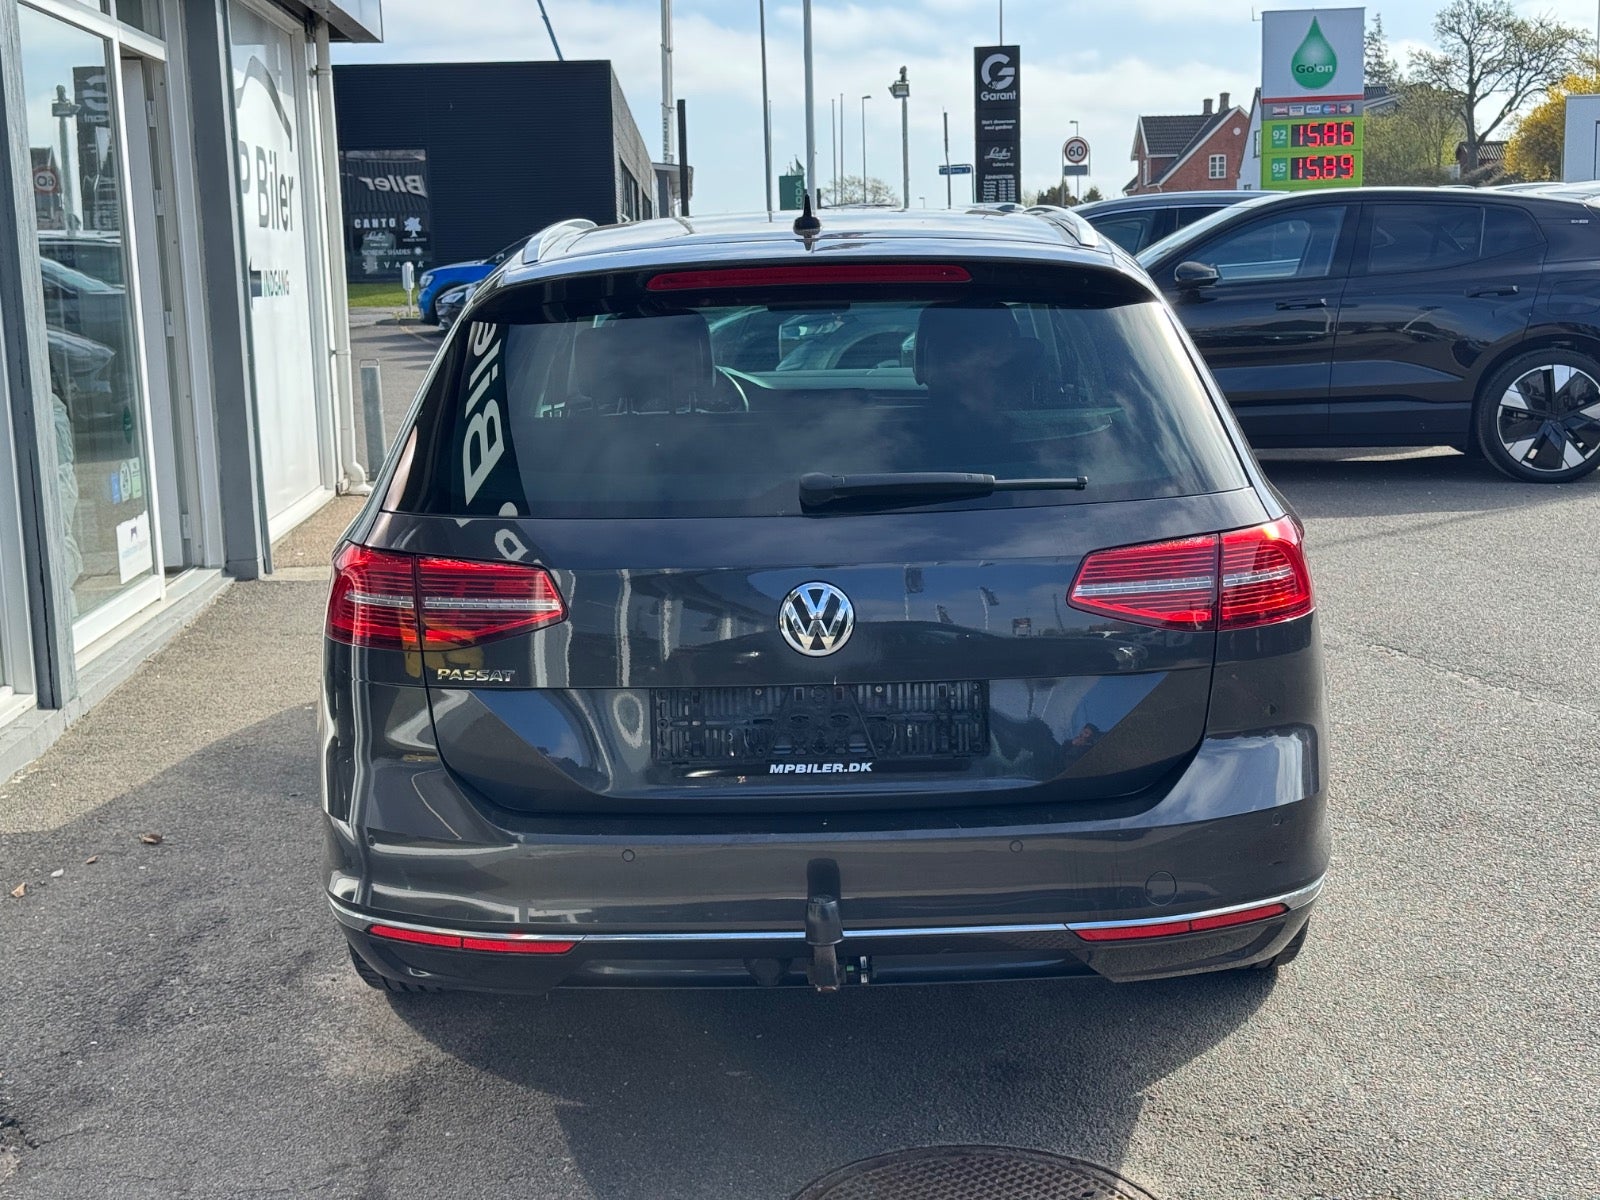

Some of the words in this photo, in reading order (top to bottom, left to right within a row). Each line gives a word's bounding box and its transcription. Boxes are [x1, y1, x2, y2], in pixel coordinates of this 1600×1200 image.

[980, 90, 1017, 101] Garant
[1272, 129, 1287, 140] 92
[1299, 122, 1354, 147] 15.86
[1068, 145, 1084, 157] 60
[1272, 162, 1287, 173] 95
[1298, 154, 1354, 180] 15.89
[256, 145, 294, 232] Biler
[437, 669, 516, 682] PASSAT
[769, 762, 873, 774] MPBILER.DK
